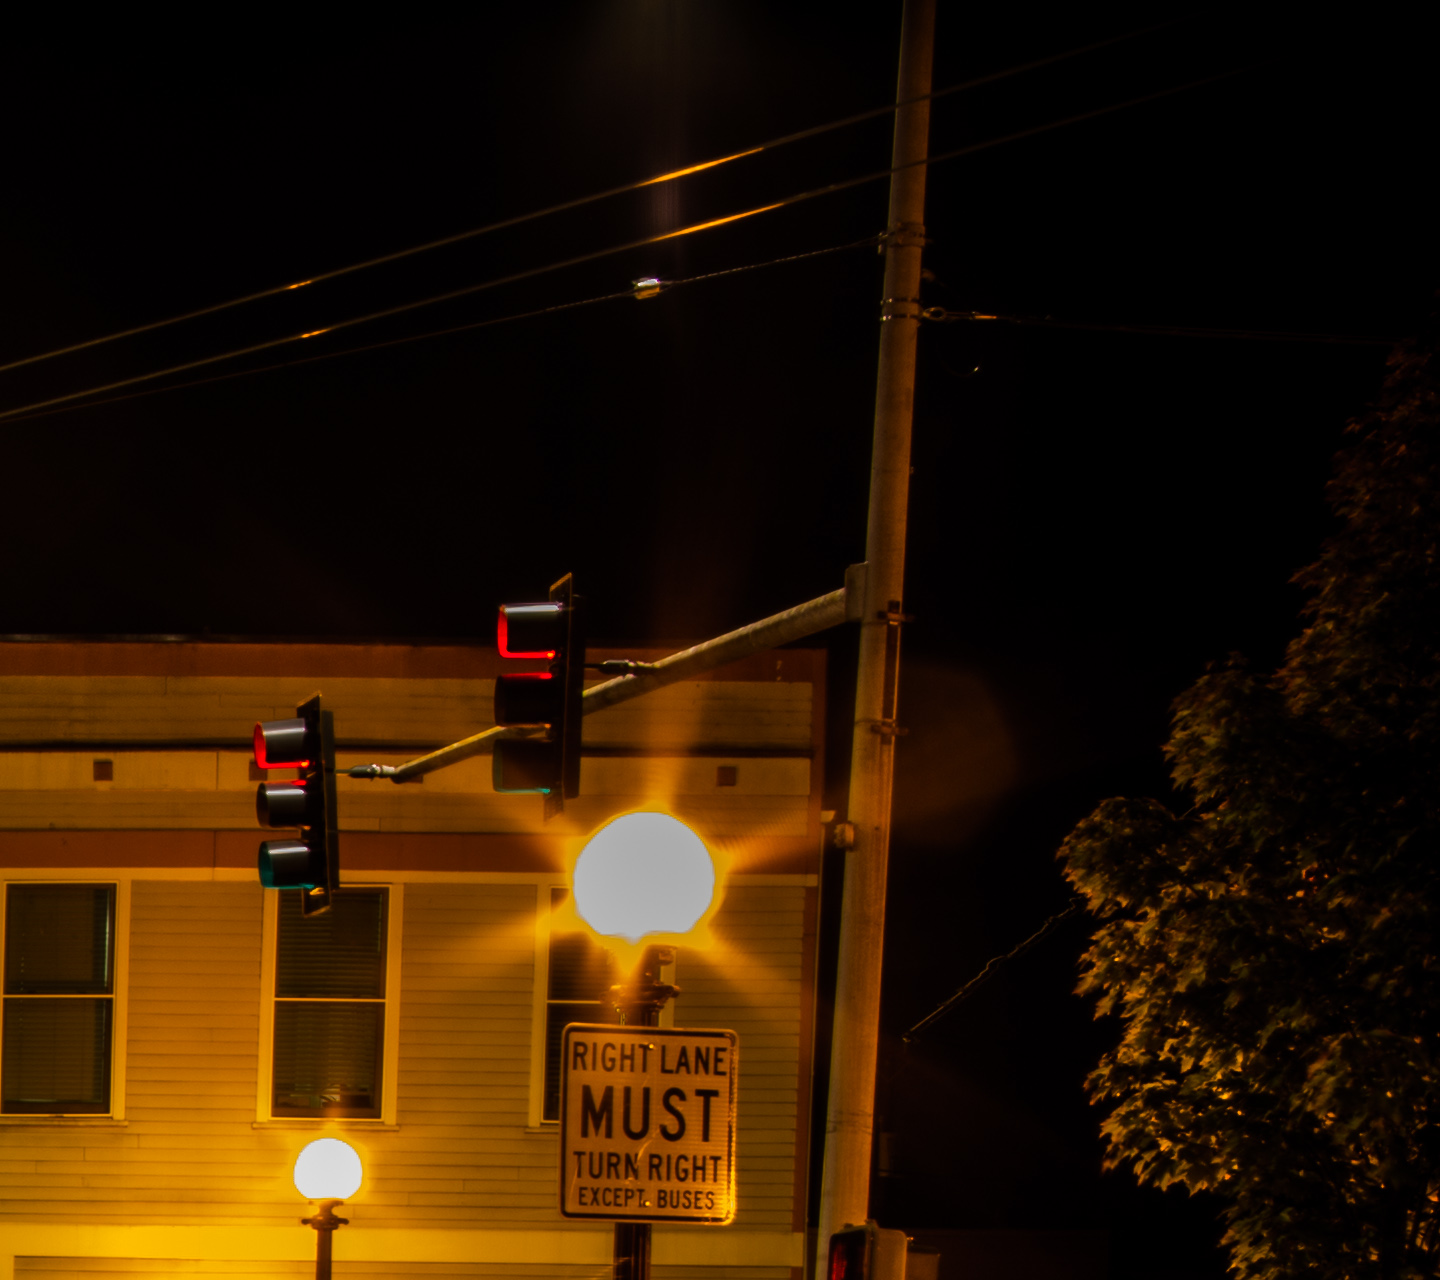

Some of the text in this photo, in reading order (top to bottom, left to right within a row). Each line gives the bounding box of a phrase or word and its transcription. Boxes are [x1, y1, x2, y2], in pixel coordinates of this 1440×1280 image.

[572, 1040, 728, 1077] RIGHT LANE
[580, 1084, 720, 1143] MUST
[572, 1150, 722, 1183] TURN RIGHT
[578, 1186, 715, 1211] EXCEPT BUSES
